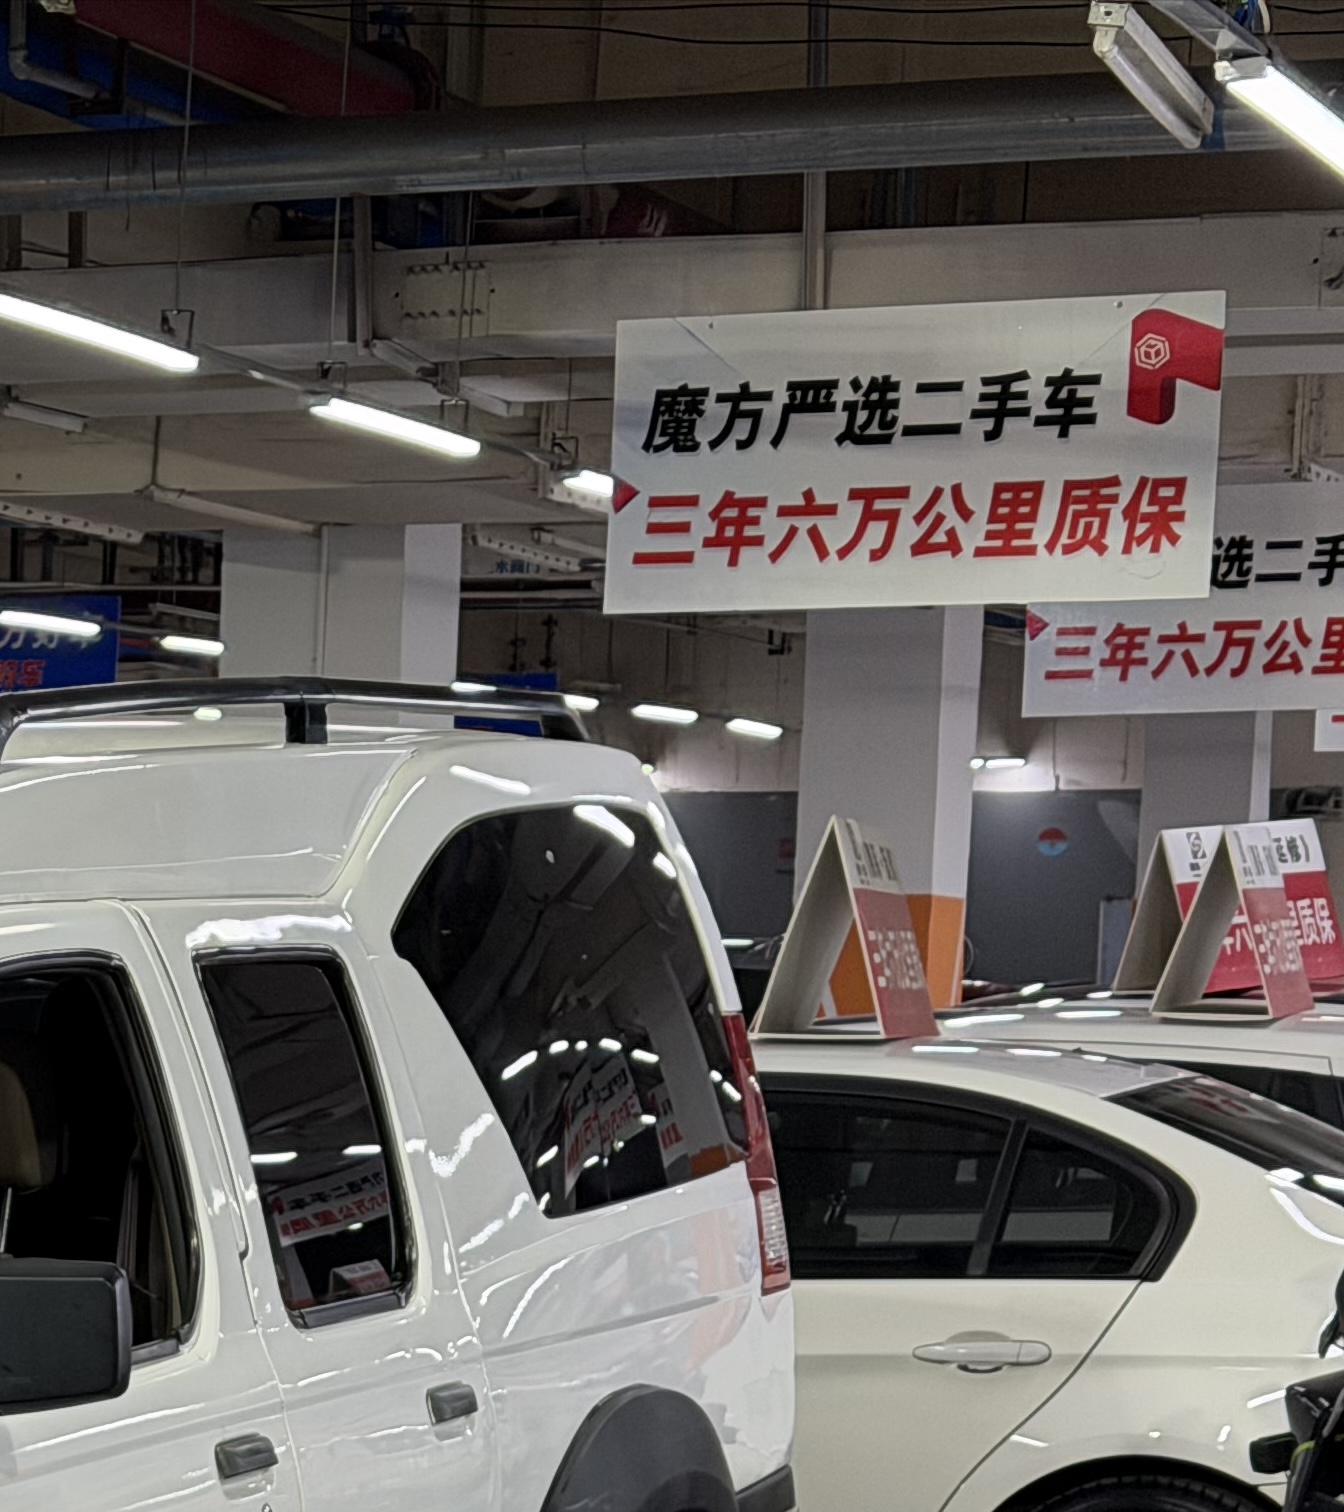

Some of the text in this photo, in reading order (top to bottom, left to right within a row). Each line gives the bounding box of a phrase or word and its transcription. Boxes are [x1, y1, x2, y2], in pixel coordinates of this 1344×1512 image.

[642, 368, 1104, 455] 魔方严选二手车
[632, 474, 1189, 568] 三年六万公里质保
